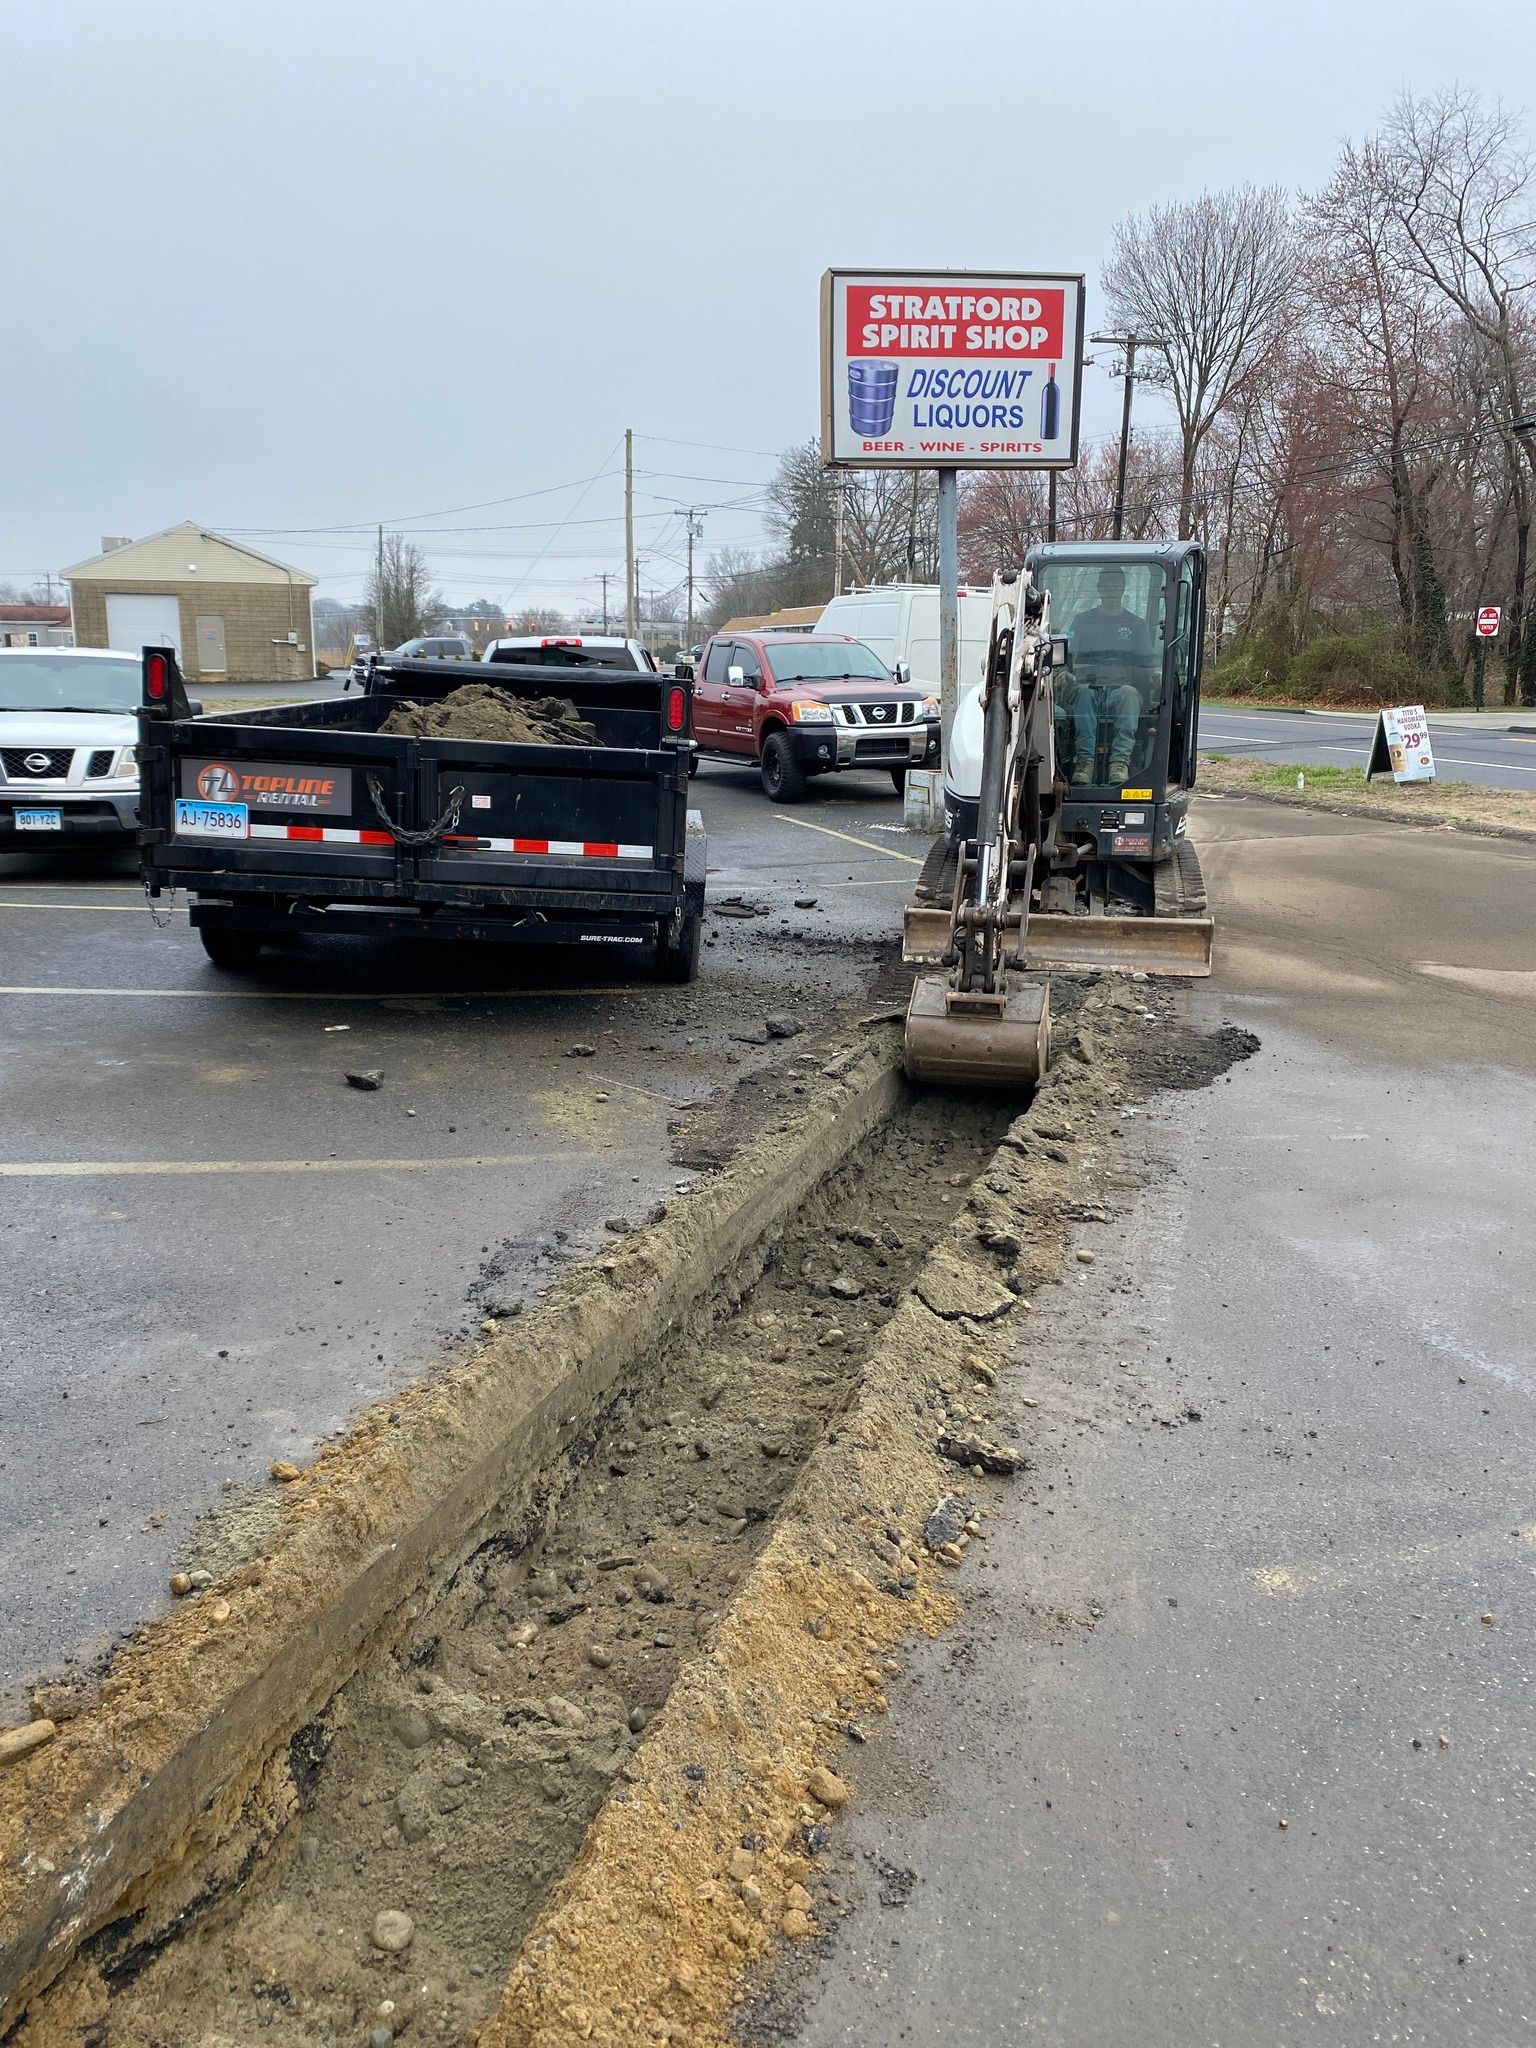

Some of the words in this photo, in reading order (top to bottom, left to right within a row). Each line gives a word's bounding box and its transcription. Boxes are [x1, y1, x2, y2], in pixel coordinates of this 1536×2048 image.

[869, 294, 1042, 321] STRATFORD
[862, 323, 956, 349] SPIRIT
[966, 325, 1049, 350] SHOP
[906, 368, 1032, 399] DISCOUNT
[913, 404, 1024, 429] LIQUORS
[862, 441, 904, 452] BEER
[919, 442, 965, 452] WINE
[980, 442, 1042, 453] SPIRITS
[1396, 714, 1425, 724] HANDMADE
[1403, 722, 1421, 731] VODKA
[241, 775, 336, 795] TOPLINE
[256, 791, 319, 807] RENTAL
[580, 934, 644, 943] SURE-TRAC.COM
